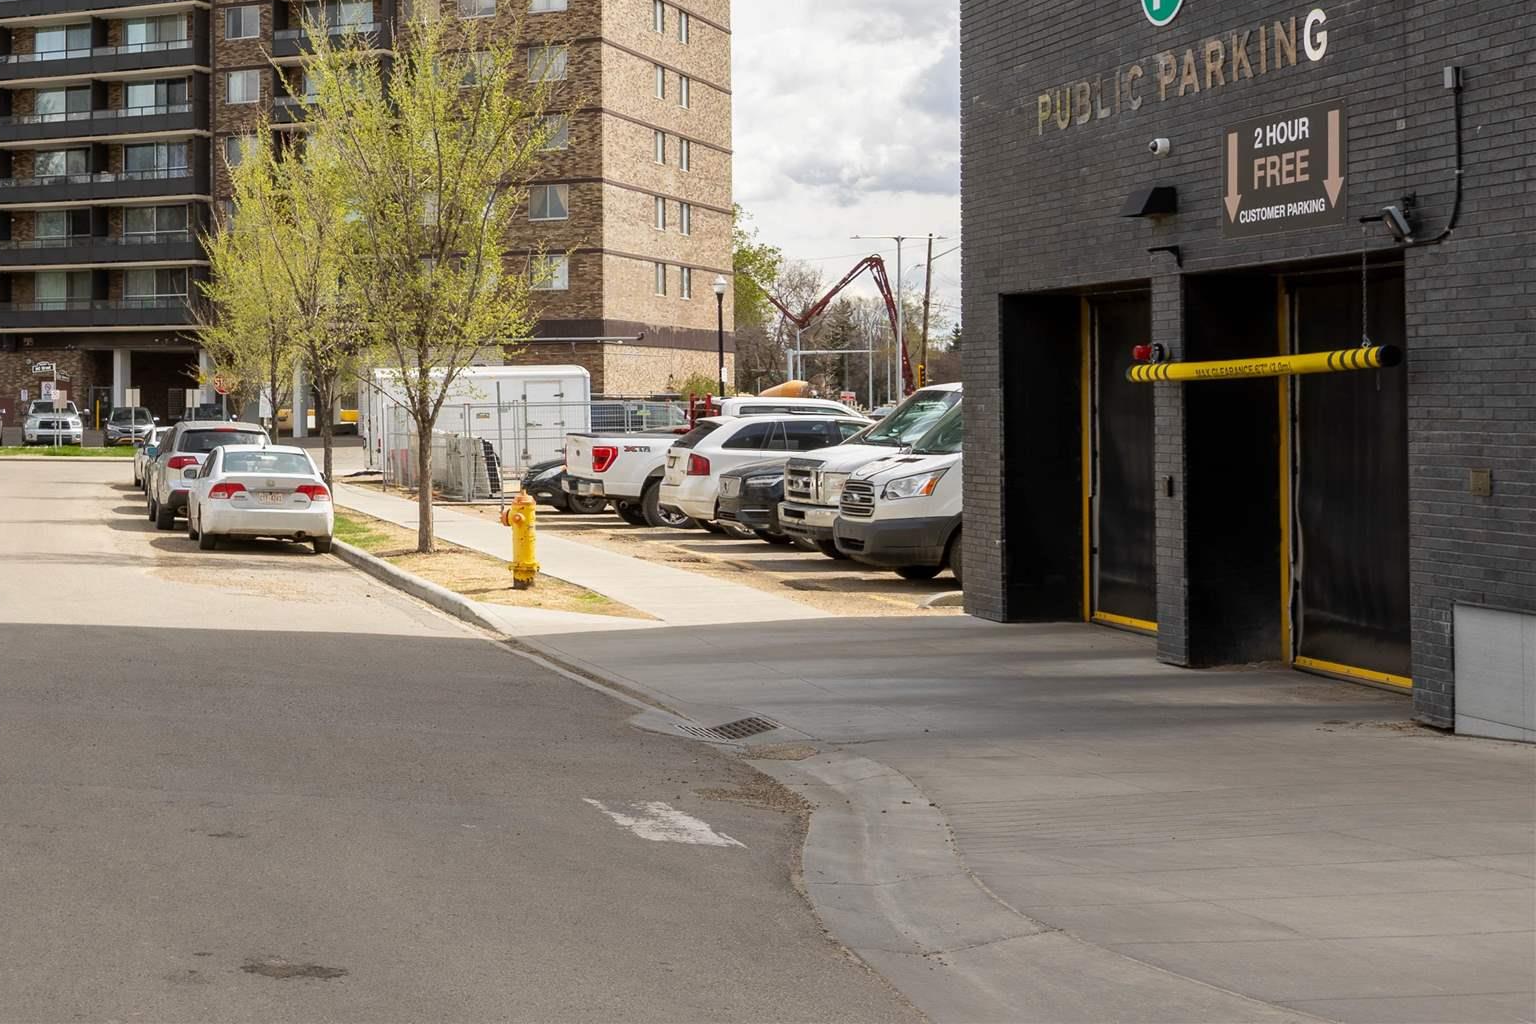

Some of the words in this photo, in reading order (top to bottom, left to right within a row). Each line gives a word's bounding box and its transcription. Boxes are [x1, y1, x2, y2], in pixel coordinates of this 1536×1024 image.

[1037, 64, 1144, 137] PUBLIC
[1157, 8, 1328, 101] PARKING
[1253, 127, 1264, 149] 2
[1266, 117, 1310, 147] HOUR
[1253, 148, 1310, 191] FREE
[1239, 204, 1286, 224] CUSTOMER
[1287, 197, 1326, 217] PARKING
